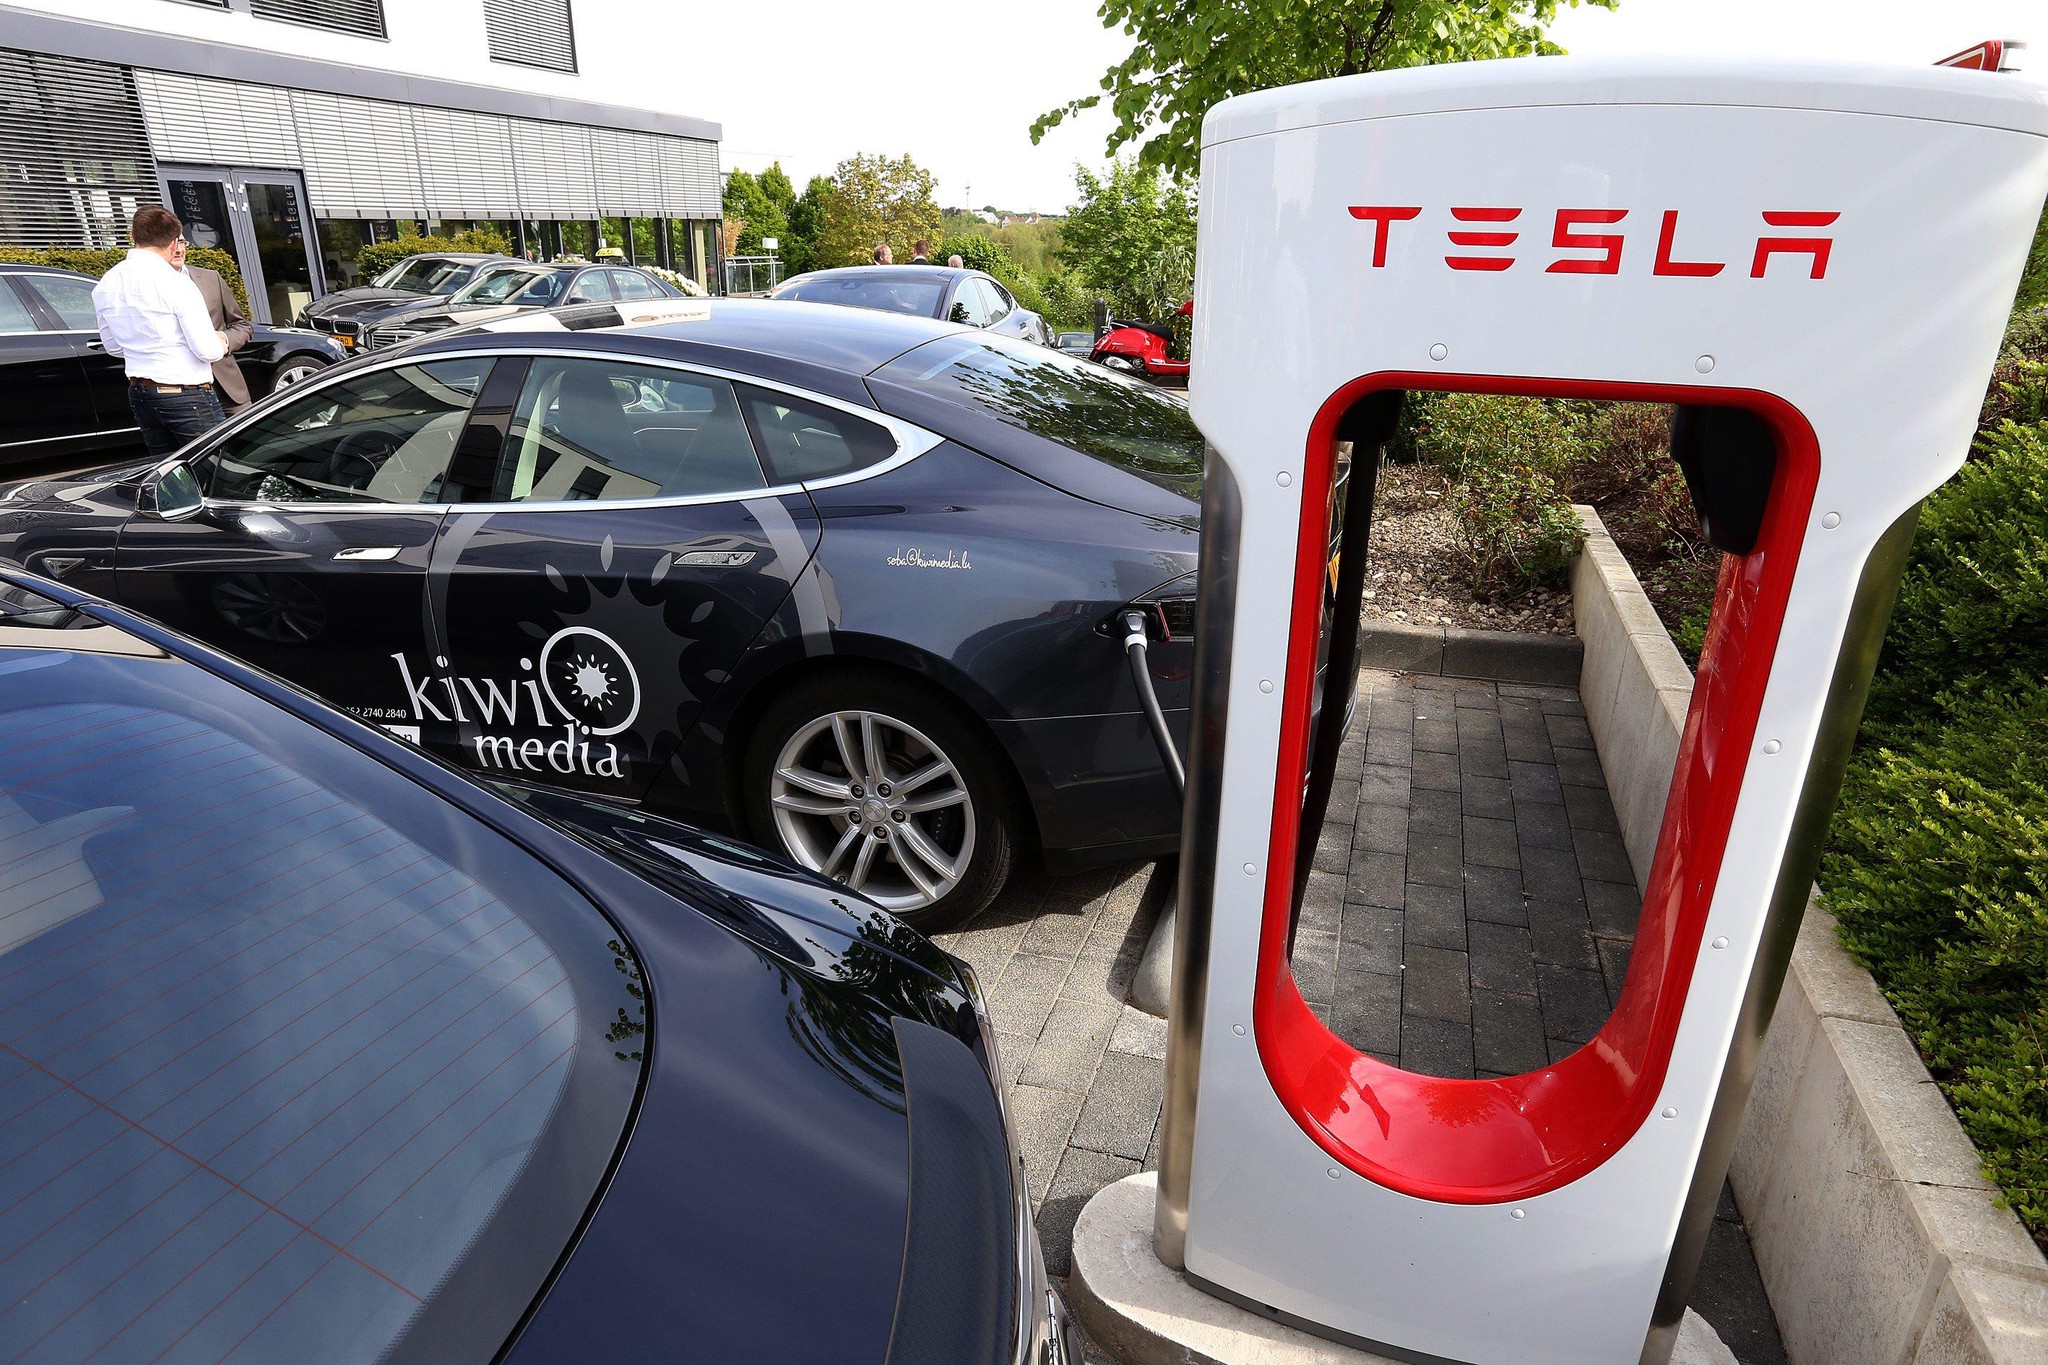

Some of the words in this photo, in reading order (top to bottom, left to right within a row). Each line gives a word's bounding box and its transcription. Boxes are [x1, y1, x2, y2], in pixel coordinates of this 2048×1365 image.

[1347, 205, 1842, 281] TESLA
[886, 547, 972, 570] seba@kiwimedia.lu
[346, 706, 361, 716] 52
[362, 707, 384, 717] 2740
[385, 708, 407, 719] 2840
[390, 652, 553, 727] kiwi
[472, 723, 625, 778] media
